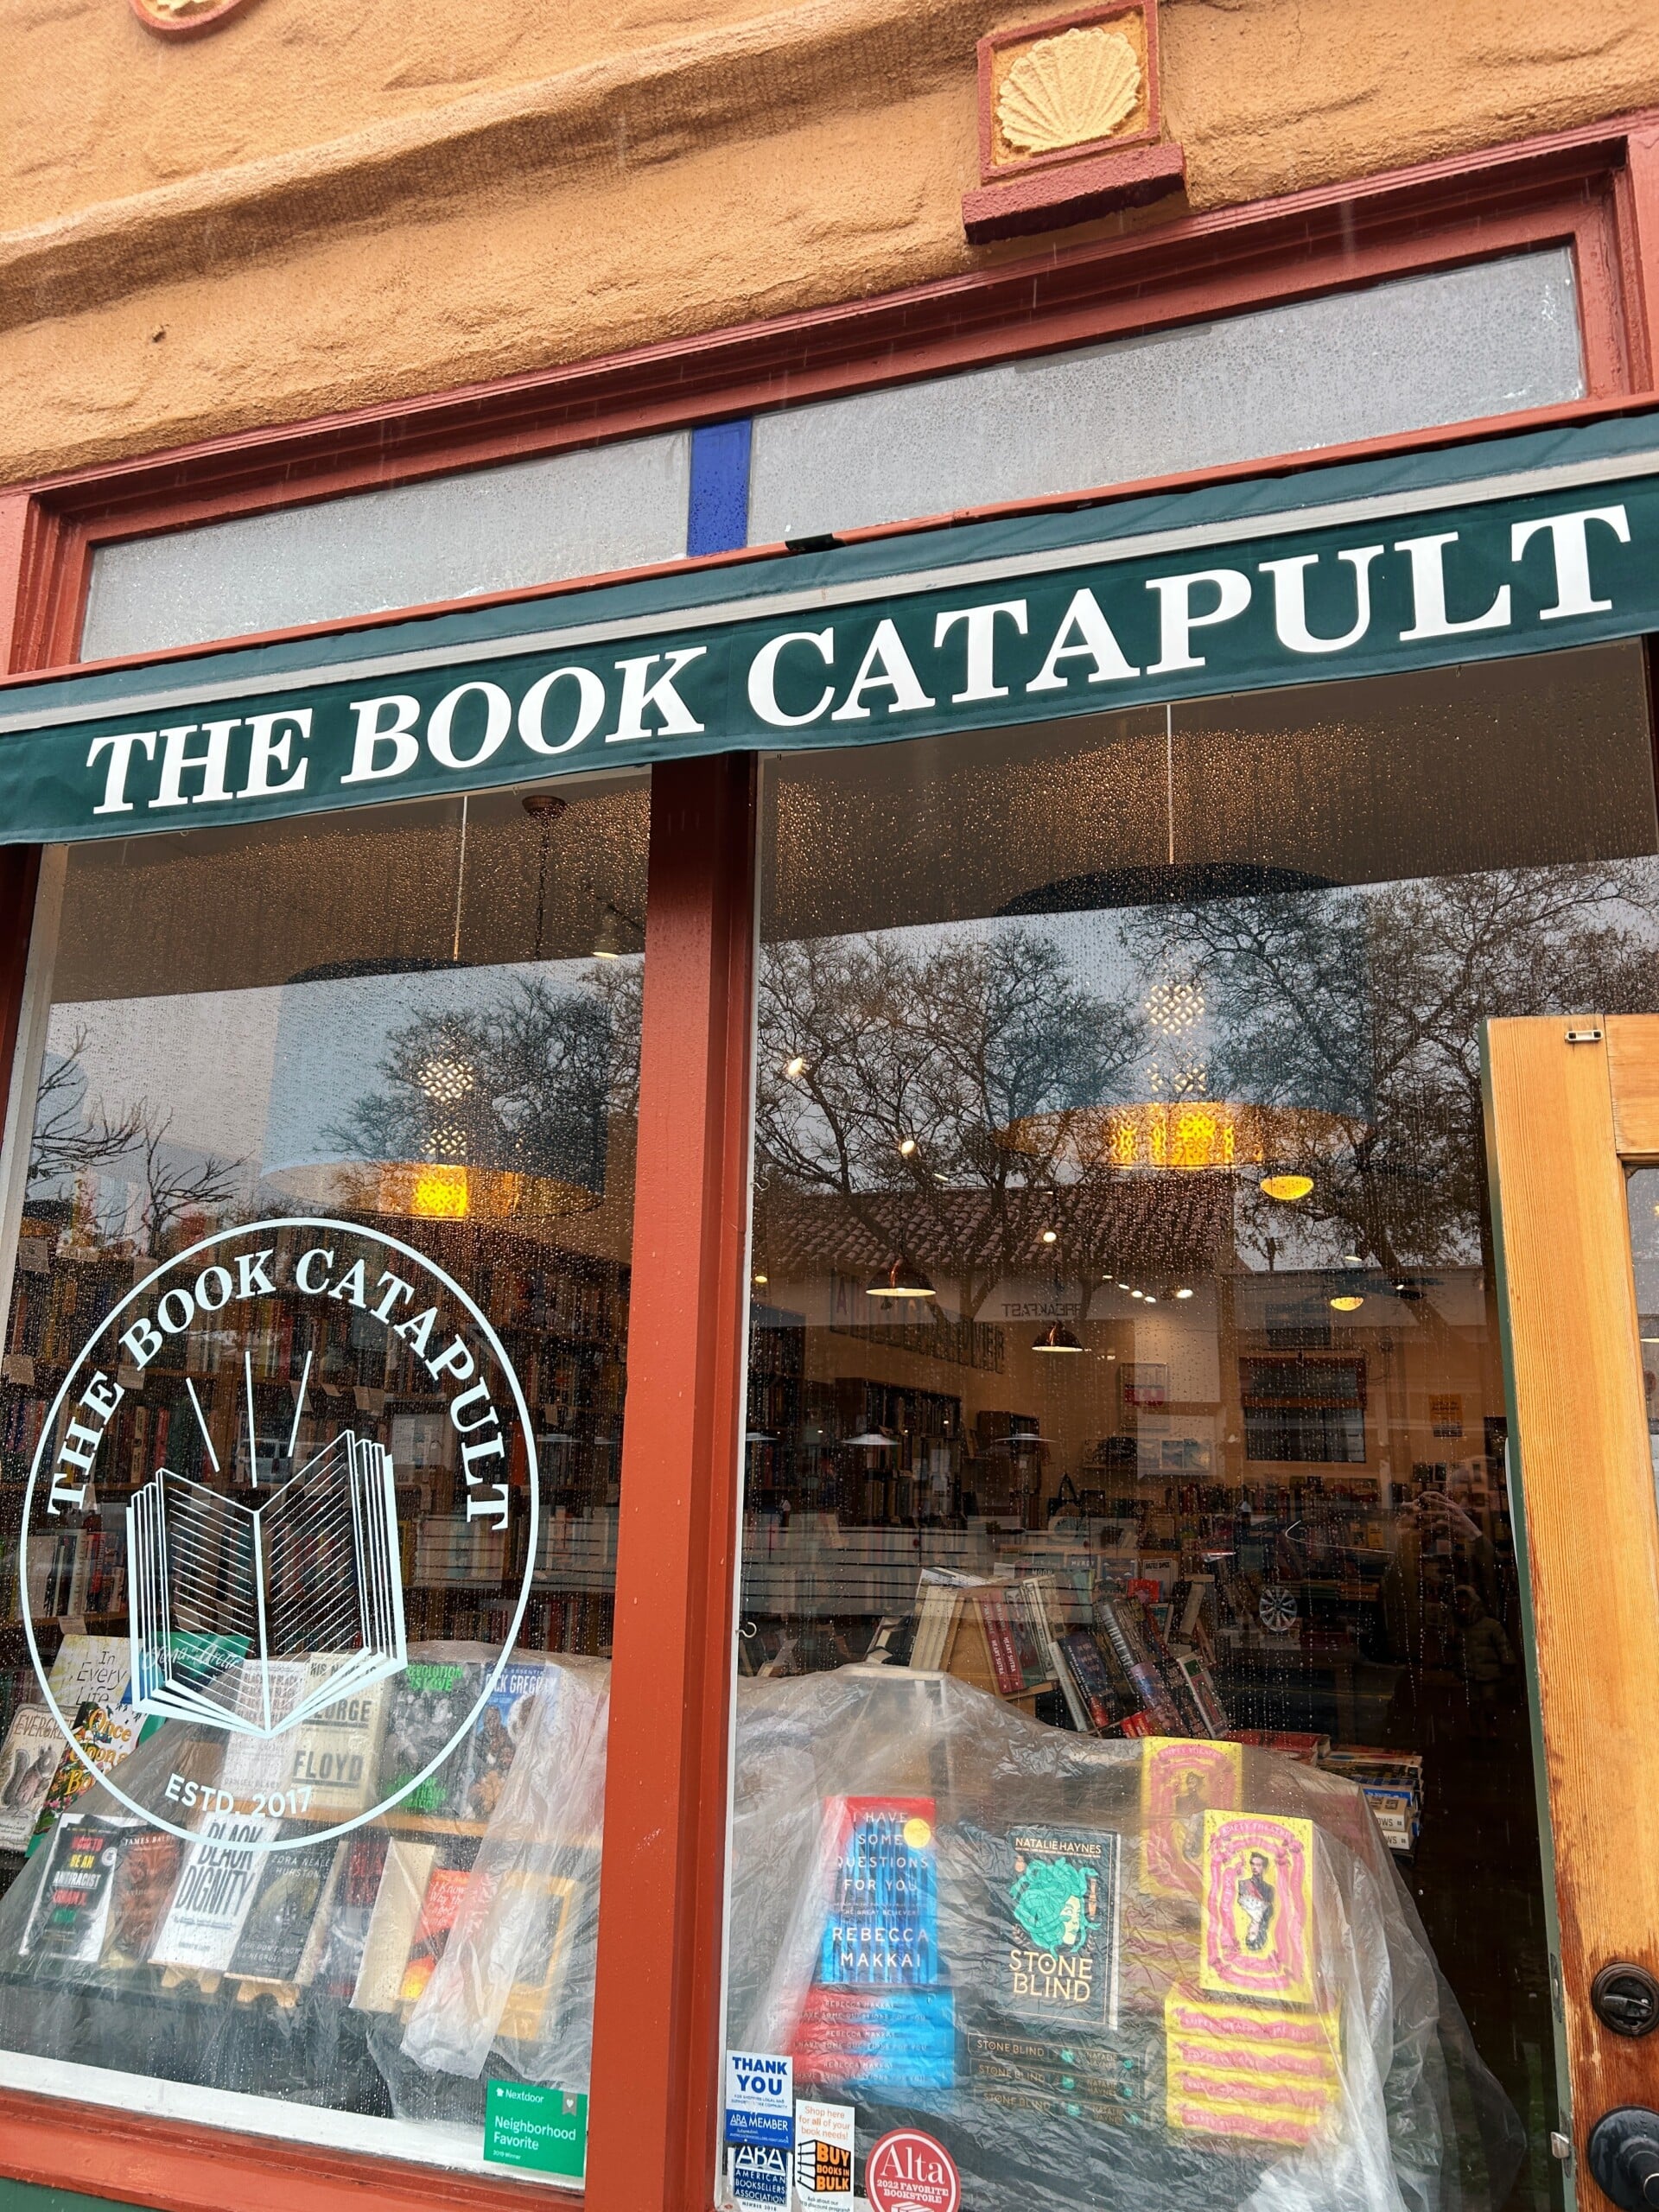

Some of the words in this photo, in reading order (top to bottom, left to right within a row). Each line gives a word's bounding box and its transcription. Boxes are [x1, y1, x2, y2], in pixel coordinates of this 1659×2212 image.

[86, 707, 314, 815] THE
[341, 646, 708, 785] BOOK
[747, 505, 1630, 728] CATAPULT
[48, 1371, 125, 1516] THE
[118, 1249, 278, 1371] BOOK
[296, 1249, 510, 1531] CATAPULT
[98, 1650, 117, 1665] In
[77, 1662, 127, 1691] Every
[486, 1674, 508, 1693] DCK
[75, 1686, 110, 1707] Life
[306, 1699, 372, 1723] EORGE
[13, 1714, 75, 1740] EVERGRE
[89, 1708, 132, 1742] Once
[293, 1750, 365, 1783] FLOYD
[164, 1772, 242, 1816] ESTD.
[251, 1785, 313, 1818] 2017
[865, 1812, 908, 1823] HAVE
[857, 1834, 904, 1846] SOME
[1015, 1837, 1058, 1851] NATALIE
[1059, 1841, 1102, 1854] HAYNES
[836, 1856, 929, 1868] QUESTIONS
[174, 1864, 257, 1917] DIGNITY
[843, 1878, 877, 1891] FOR
[886, 1878, 918, 1891] YOU
[832, 1928, 930, 1943] REBECCA
[840, 1953, 921, 1967] MAKKAI
[1008, 1948, 1093, 1980] STONE
[1013, 1972, 1091, 2003] BLIND
[976, 2039, 1010, 2053] STONE
[1013, 2044, 1045, 2057] BLIND
[732, 2056, 788, 2075] THANK
[736, 2074, 783, 2095] YOU
[505, 2088, 544, 2103] Nextdoor
[730, 2113, 747, 2126] ABA
[748, 2117, 788, 2132] MEMBER
[799, 2114, 810, 2125] for
[811, 2116, 821, 2126] all
[823, 2117, 832, 2127] of
[832, 2120, 851, 2131] your
[804, 2106, 825, 2120] Shop
[827, 2107, 845, 2119] here
[494, 2114, 576, 2141] Neighborhood
[801, 2125, 821, 2138] book
[823, 2128, 849, 2140] needs!
[493, 2131, 539, 2151] Favorite
[736, 2145, 785, 2172] ABA
[817, 2141, 850, 2167] BUY
[817, 2165, 842, 2177] BOOKS
[842, 2166, 849, 2177] IN
[880, 2144, 945, 2185] Alta
[734, 2178, 785, 2195] BOOKSELLERS
[735, 2170, 785, 2184] AMERICAN
[816, 2177, 849, 2191] BULK
[734, 2189, 785, 2204] ASSOCIATION
[877, 2178, 899, 2190] 2022
[899, 2182, 949, 2196] FAVORITE
[883, 2188, 943, 2204] BOOKSTORE
